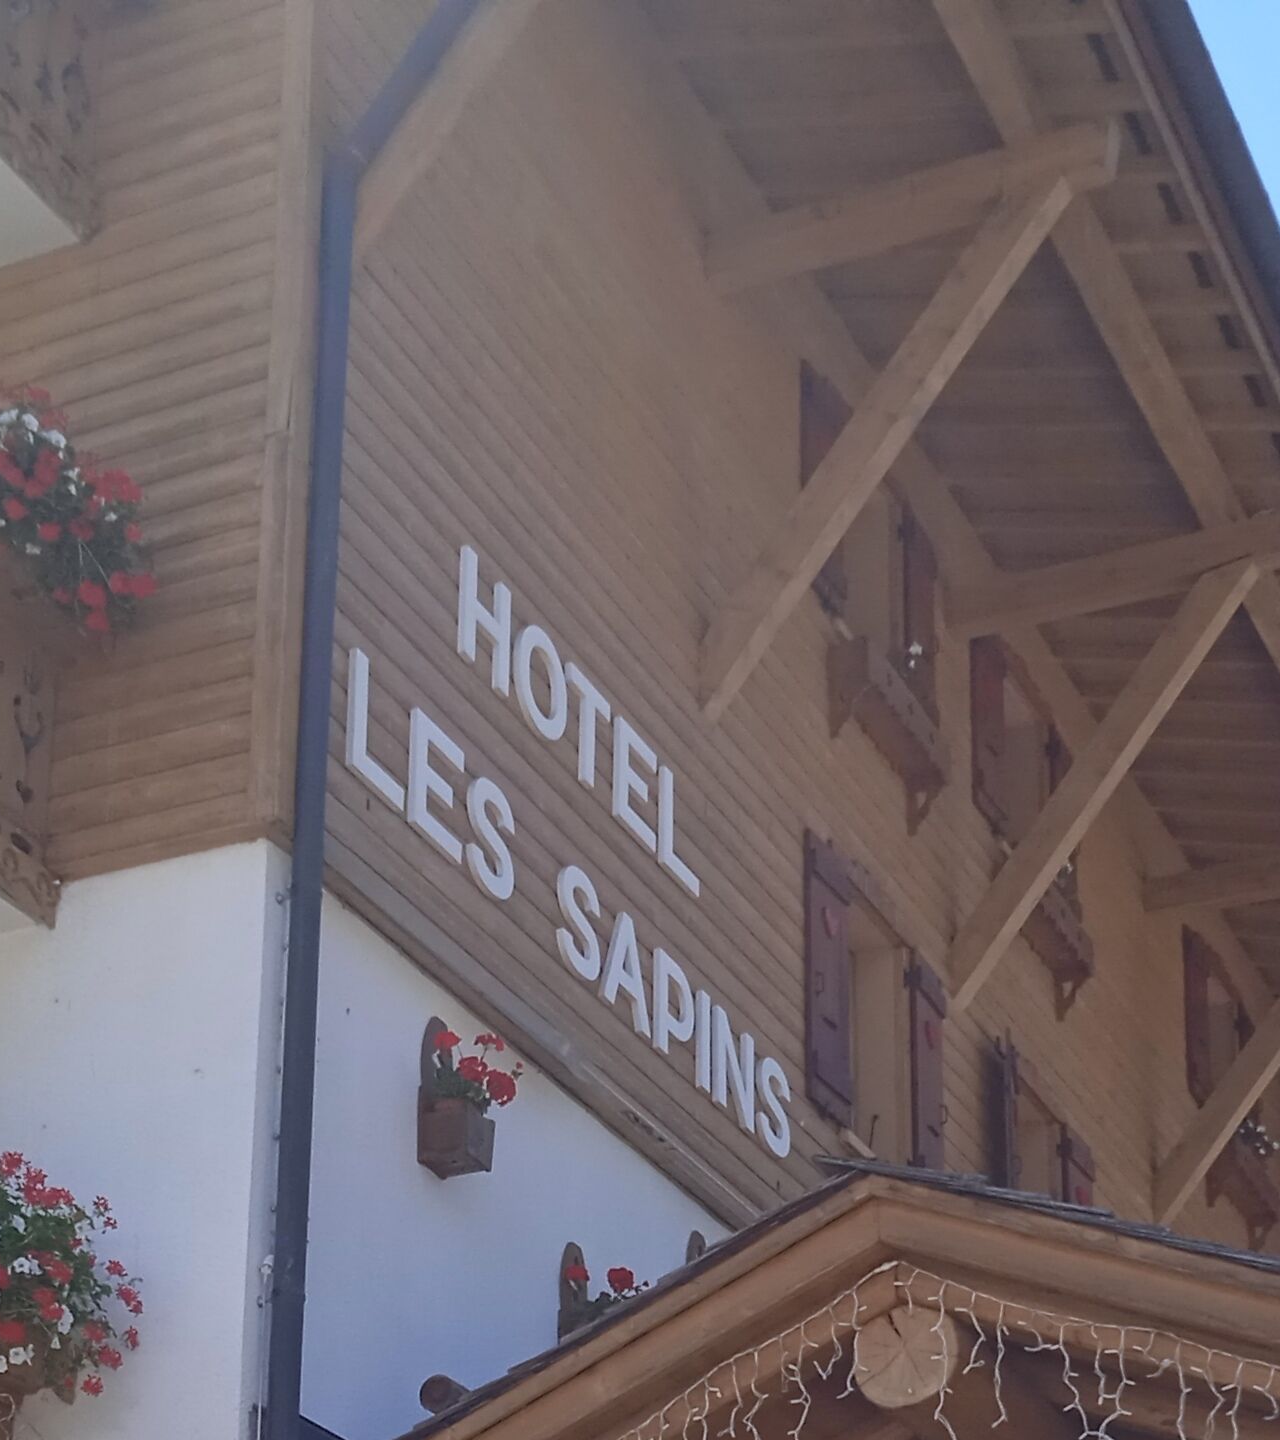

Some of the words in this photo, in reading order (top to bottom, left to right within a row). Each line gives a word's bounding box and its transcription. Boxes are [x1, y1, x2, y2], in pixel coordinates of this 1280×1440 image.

[345, 647, 515, 900] LES
[555, 865, 791, 1158] SAPINS
[456, 545, 700, 897] HOTEL
